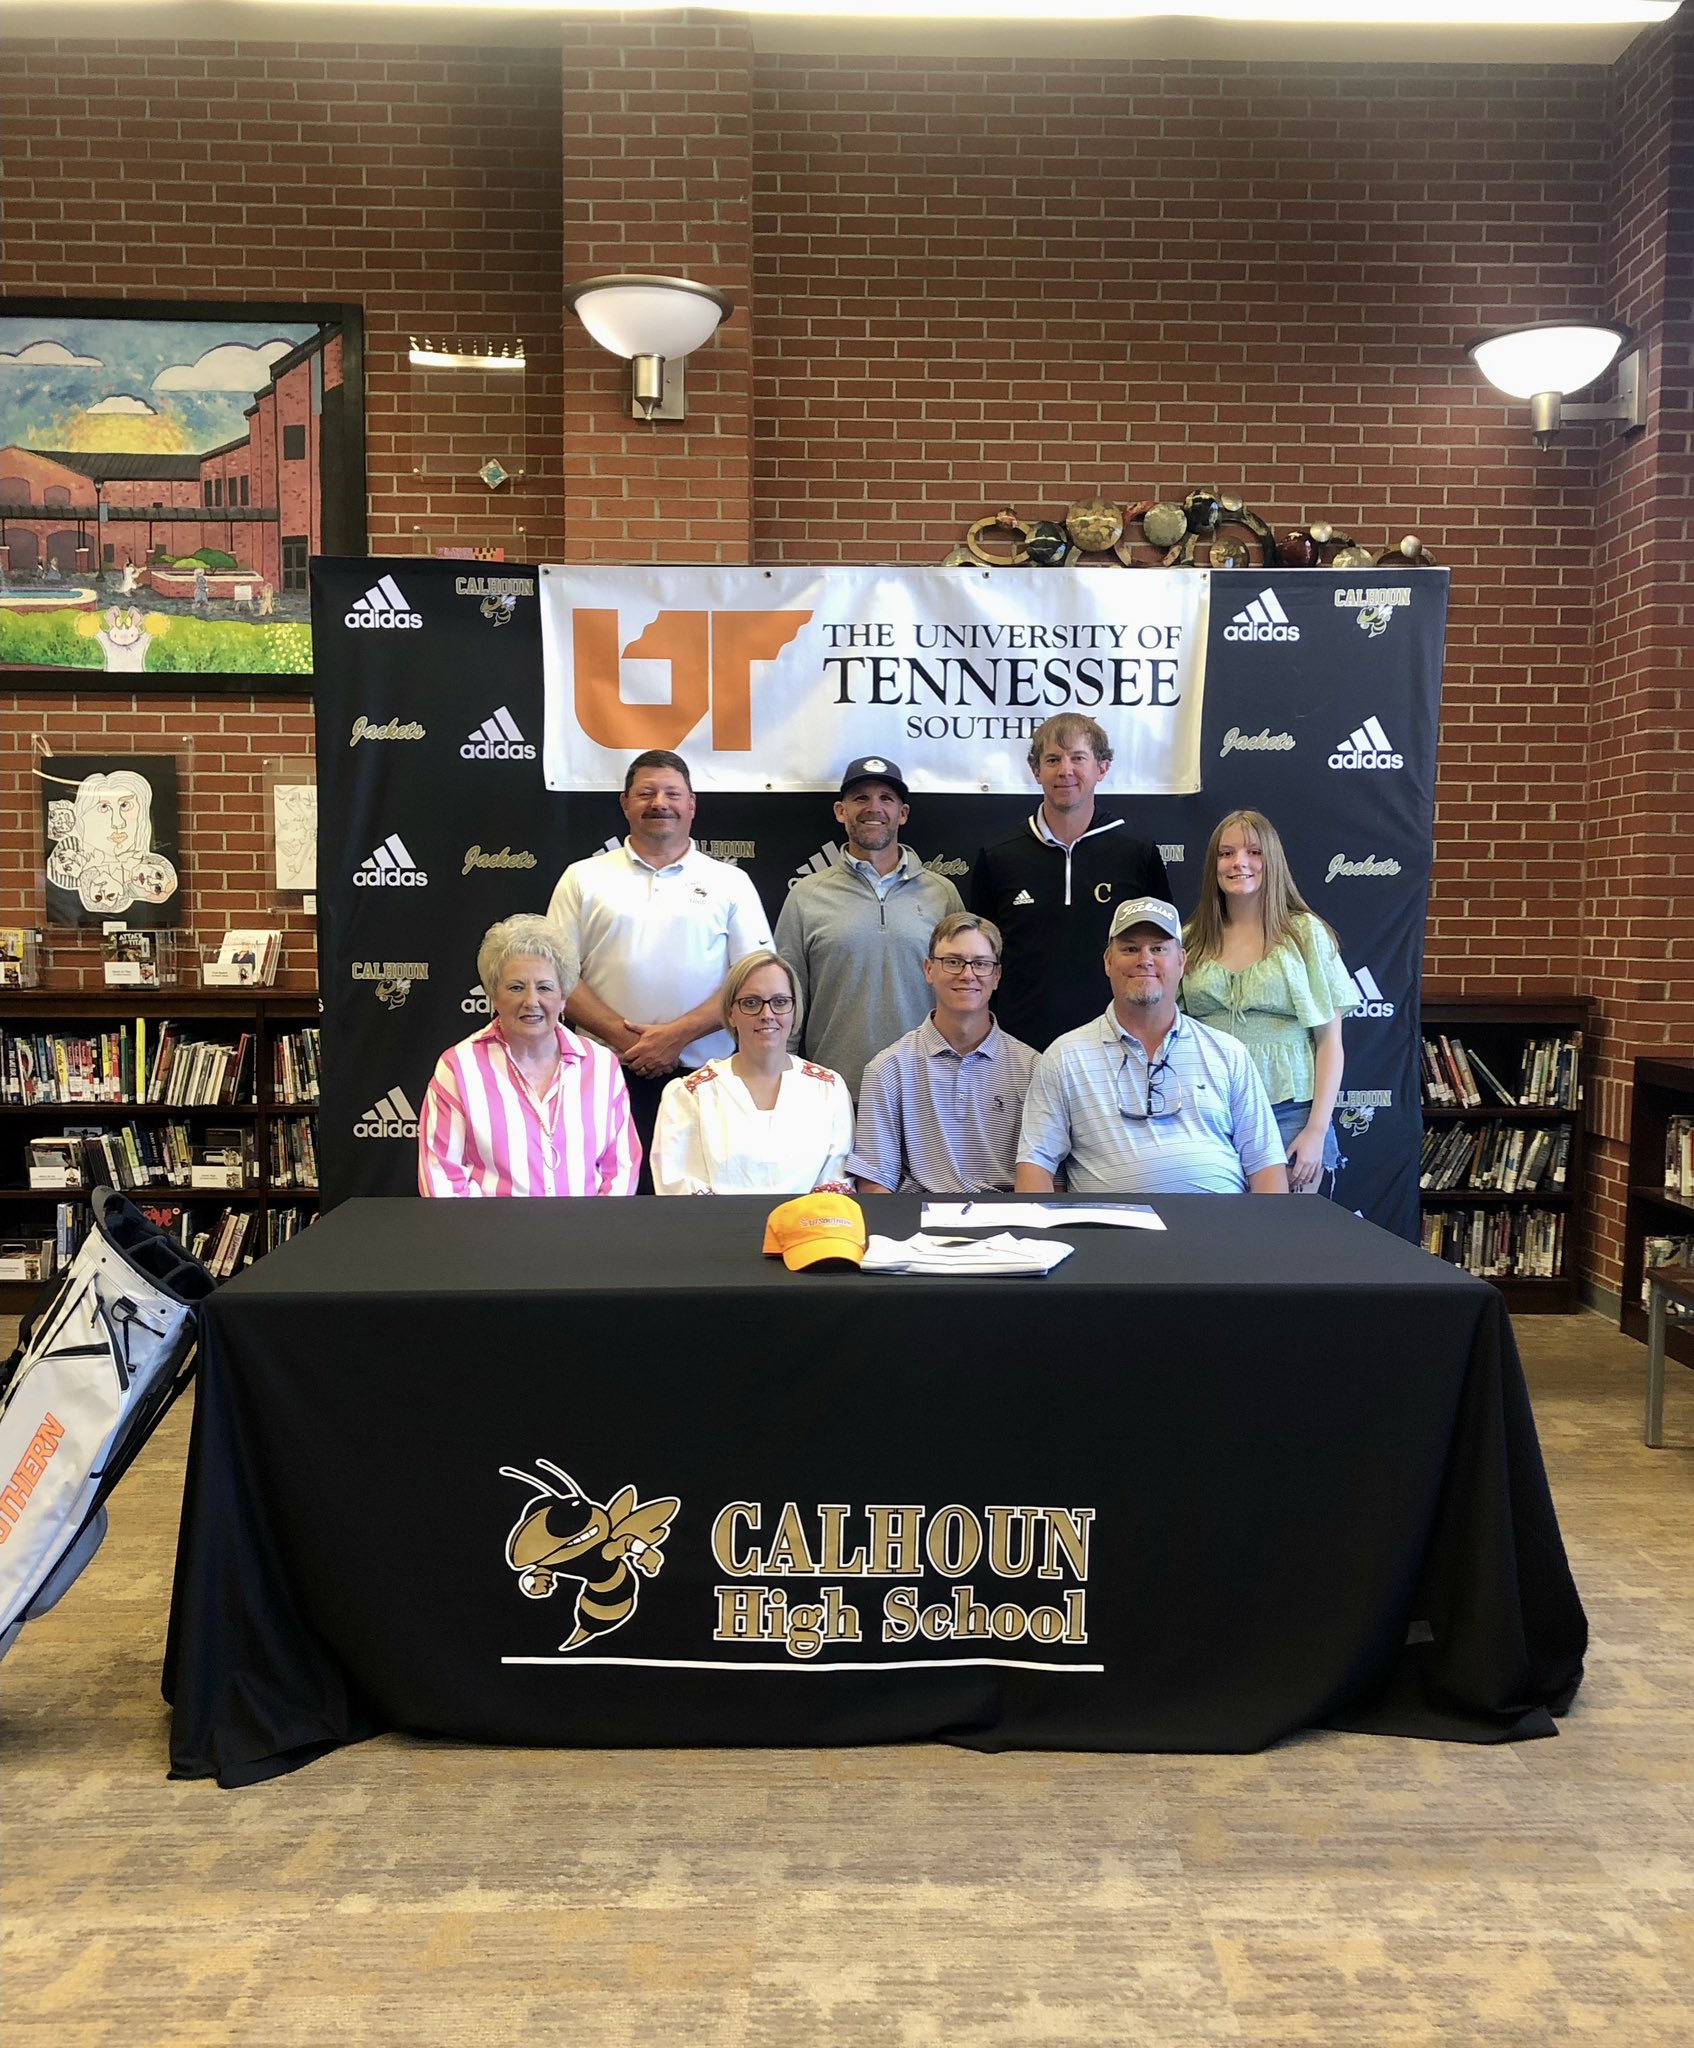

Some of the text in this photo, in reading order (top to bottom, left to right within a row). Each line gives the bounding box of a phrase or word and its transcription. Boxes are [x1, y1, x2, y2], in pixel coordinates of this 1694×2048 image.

[455, 577, 534, 596] CALHOUN
[1334, 587, 1412, 607] CALHOUN
[345, 609, 423, 629] adidas
[823, 623, 1182, 650] THE UNIVERSITY OF
[1223, 620, 1300, 642] adidas
[572, 608, 815, 751] UT
[823, 657, 1182, 707] TENNESSEE
[349, 715, 426, 747] Jackets
[906, 715, 1097, 740] SOUTHE
[460, 740, 536, 760] adidas
[1219, 726, 1296, 758] Jackets
[1328, 748, 1404, 770] adidas
[694, 839, 756, 858] LHOUN
[461, 845, 538, 875] Jackets
[922, 853, 970, 876] ckets
[1324, 853, 1402, 883] Jackets
[352, 866, 428, 888] adidas
[1094, 882, 1112, 903] C
[1119, 901, 1175, 921] Titleist
[352, 961, 429, 980] CALHOUN
[1345, 999, 1395, 1018] das
[1334, 1090, 1392, 1107] LHOUN
[353, 1119, 420, 1138] adida
[711, 1501, 1095, 1581] CALHOUN
[713, 1585, 1089, 1658] High School
